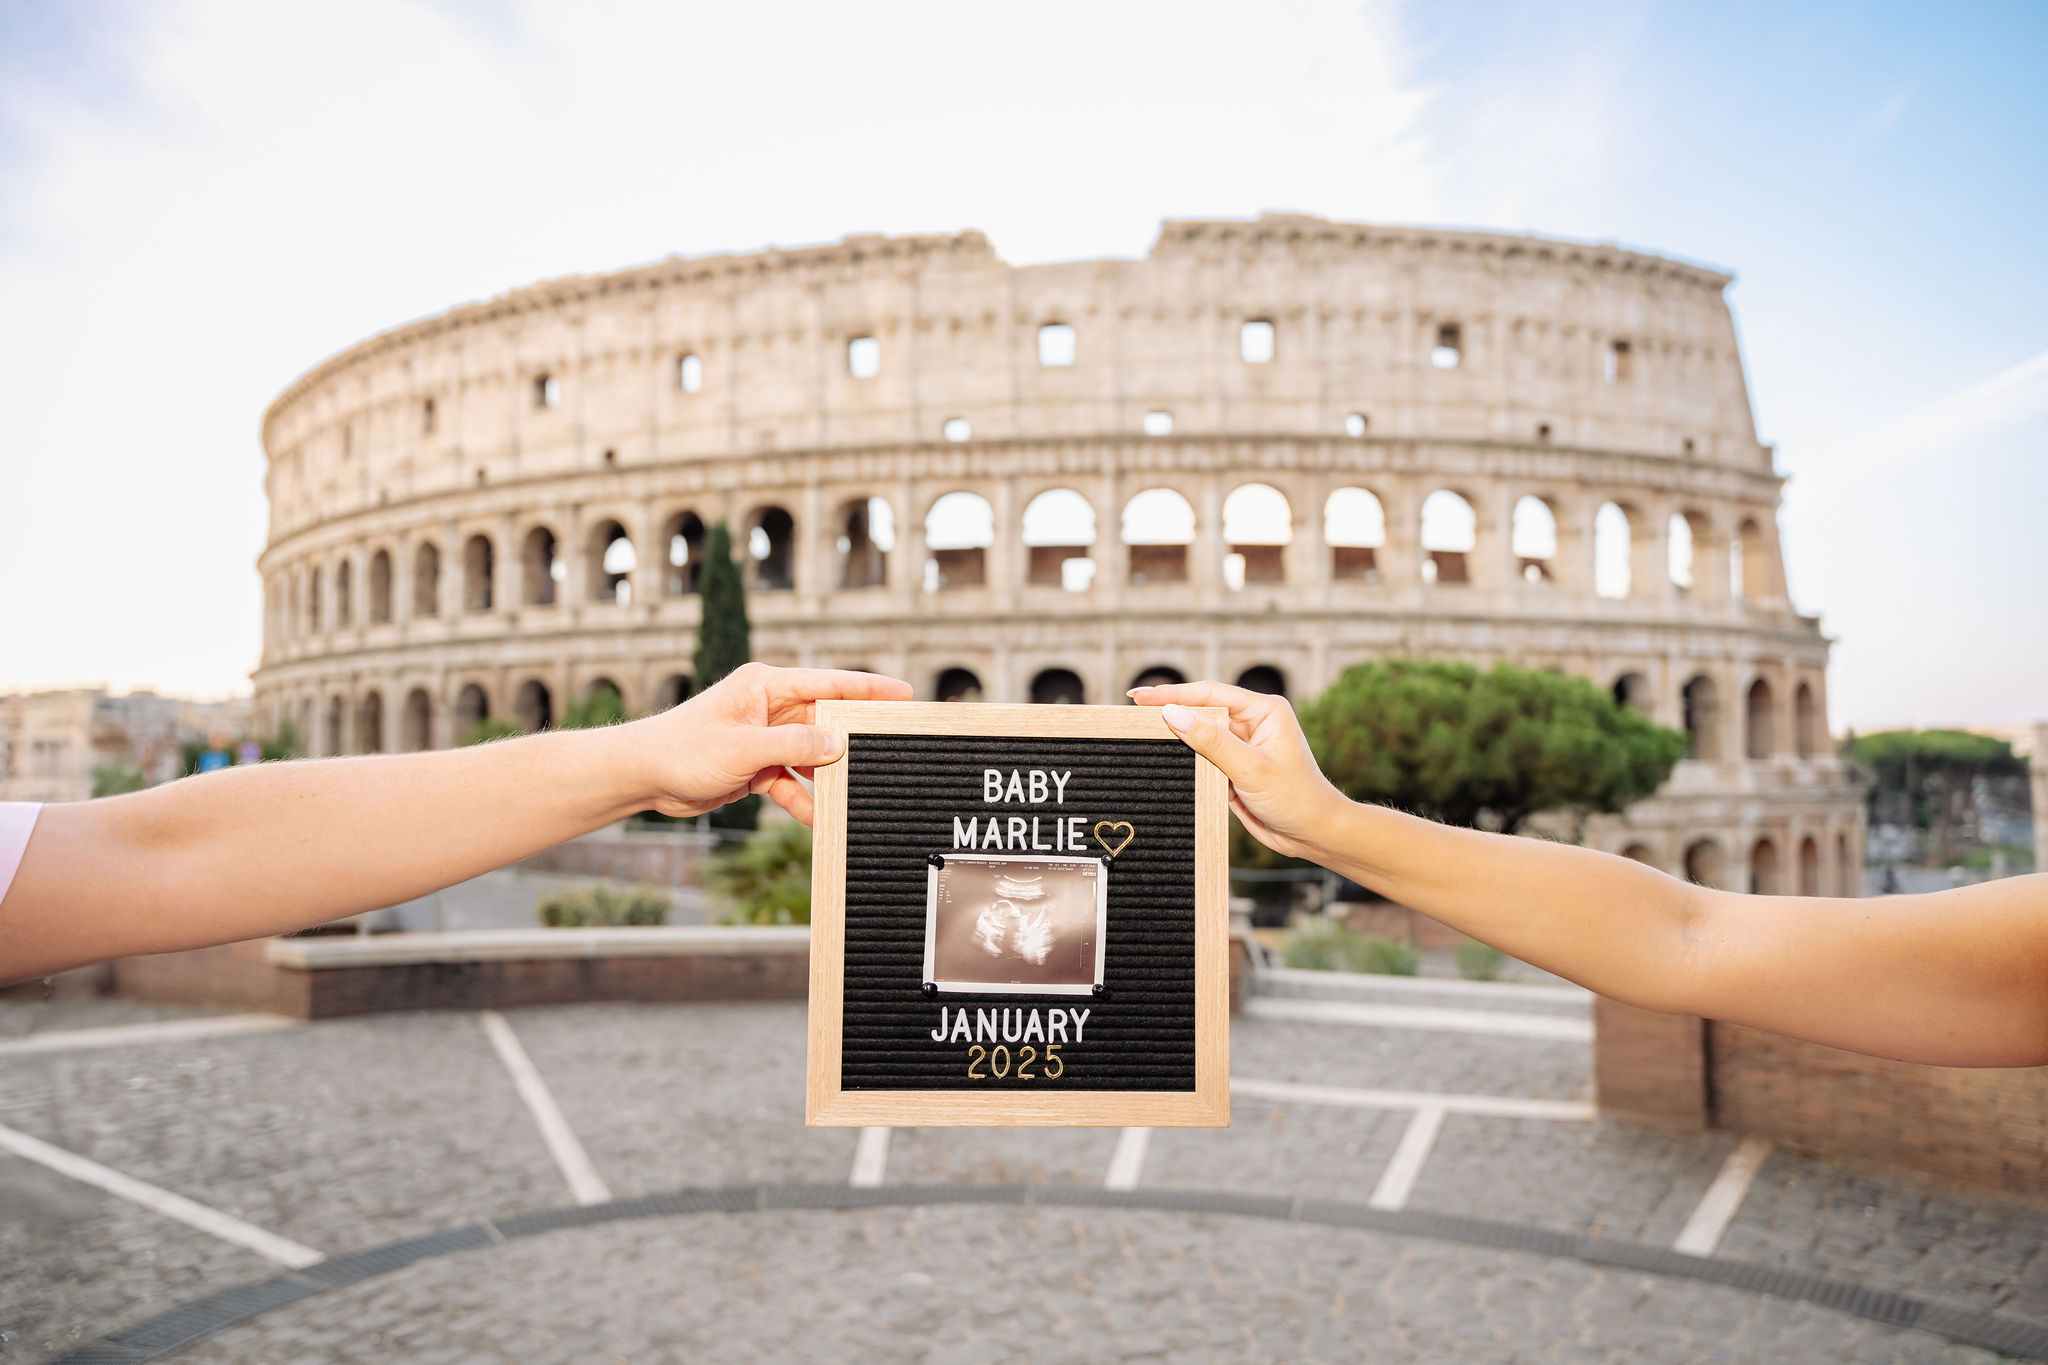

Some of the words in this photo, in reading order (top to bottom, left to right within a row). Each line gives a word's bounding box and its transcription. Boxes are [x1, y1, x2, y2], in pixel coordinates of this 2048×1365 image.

[983, 769, 1072, 804] BABY
[953, 816, 1088, 851] MARLIE
[931, 1007, 1091, 1043] JANUARY
[968, 1045, 1064, 1080] 2025
